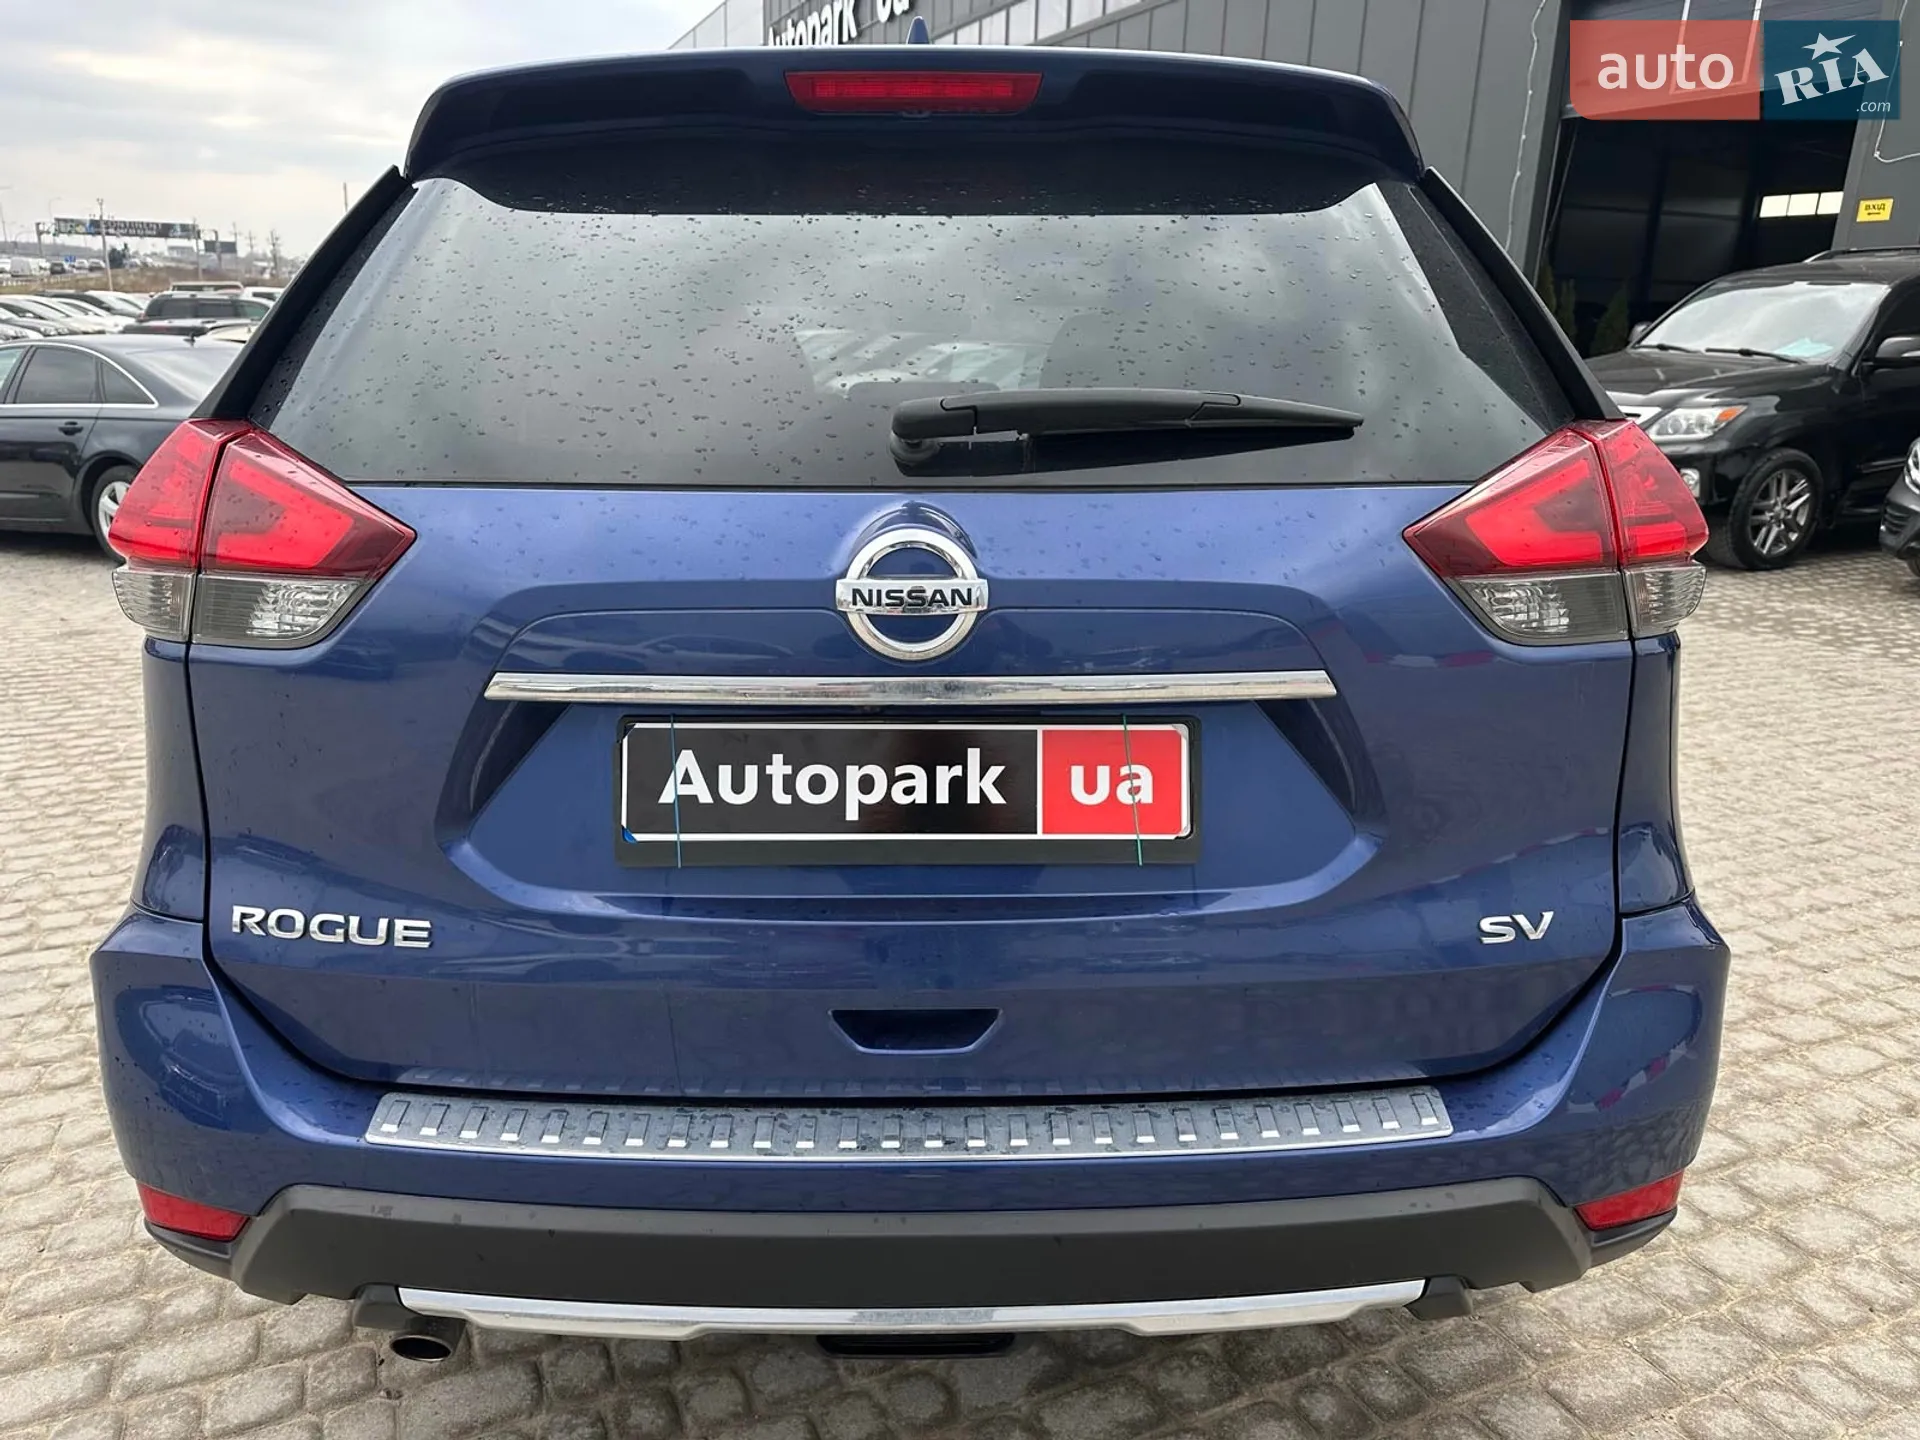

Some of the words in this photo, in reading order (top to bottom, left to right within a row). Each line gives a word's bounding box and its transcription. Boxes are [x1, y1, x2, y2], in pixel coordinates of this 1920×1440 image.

[768, 0, 858, 45] topark
[851, 587, 972, 607] NISSAN
[658, 747, 1007, 821] Autopark
[1069, 763, 1154, 806] ua
[231, 904, 433, 948] ROGUE
[1479, 911, 1555, 944] SV
